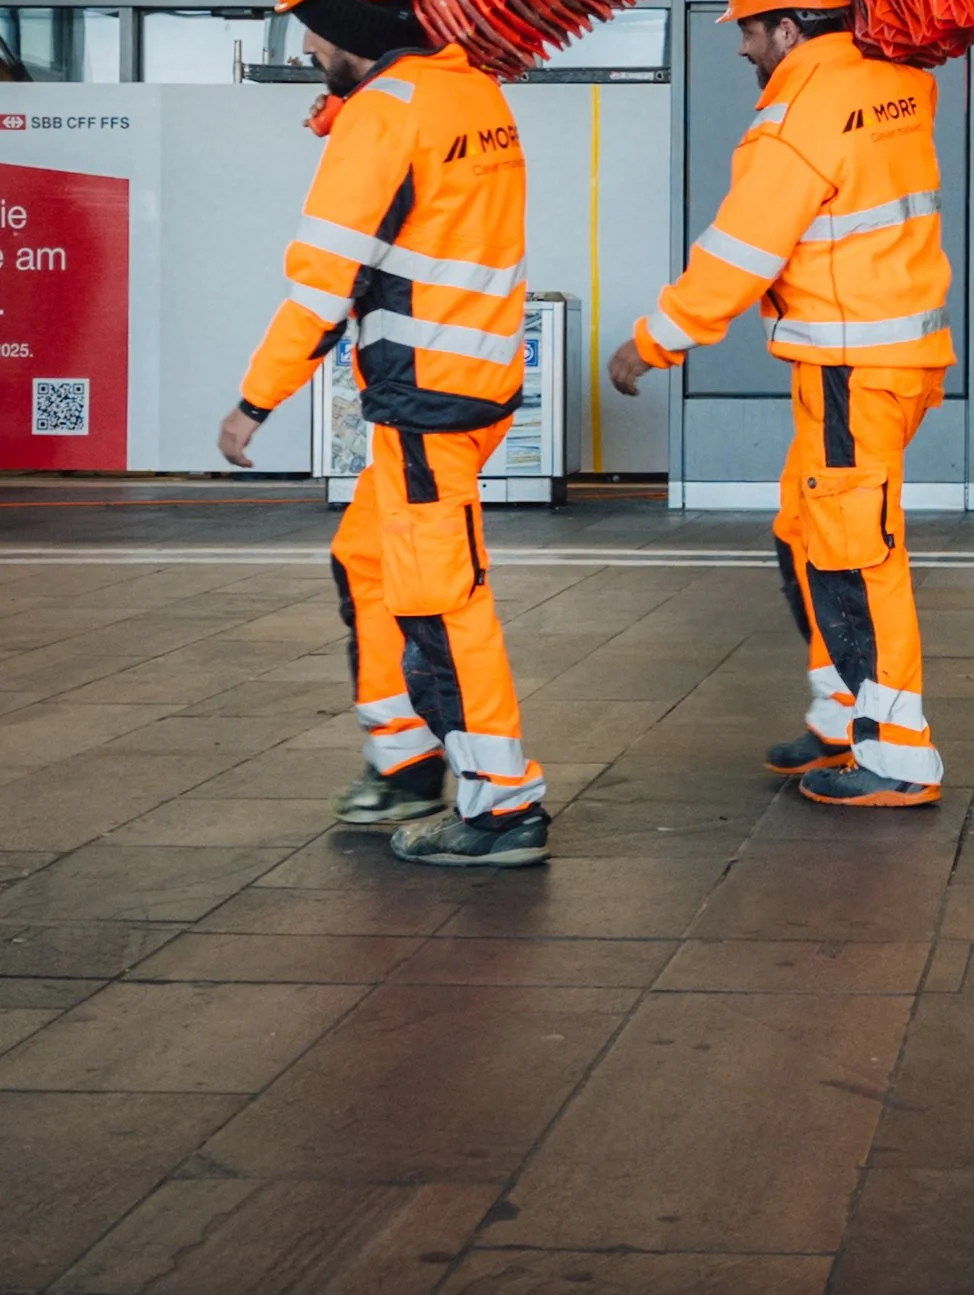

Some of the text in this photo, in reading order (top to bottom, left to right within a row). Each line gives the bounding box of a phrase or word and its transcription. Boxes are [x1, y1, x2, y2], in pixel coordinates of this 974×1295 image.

[872, 97, 917, 123] MORF
[31, 116, 131, 130] SBB CFF FFS
[15, 247, 67, 271] am
[0, 343, 34, 358] 025.
